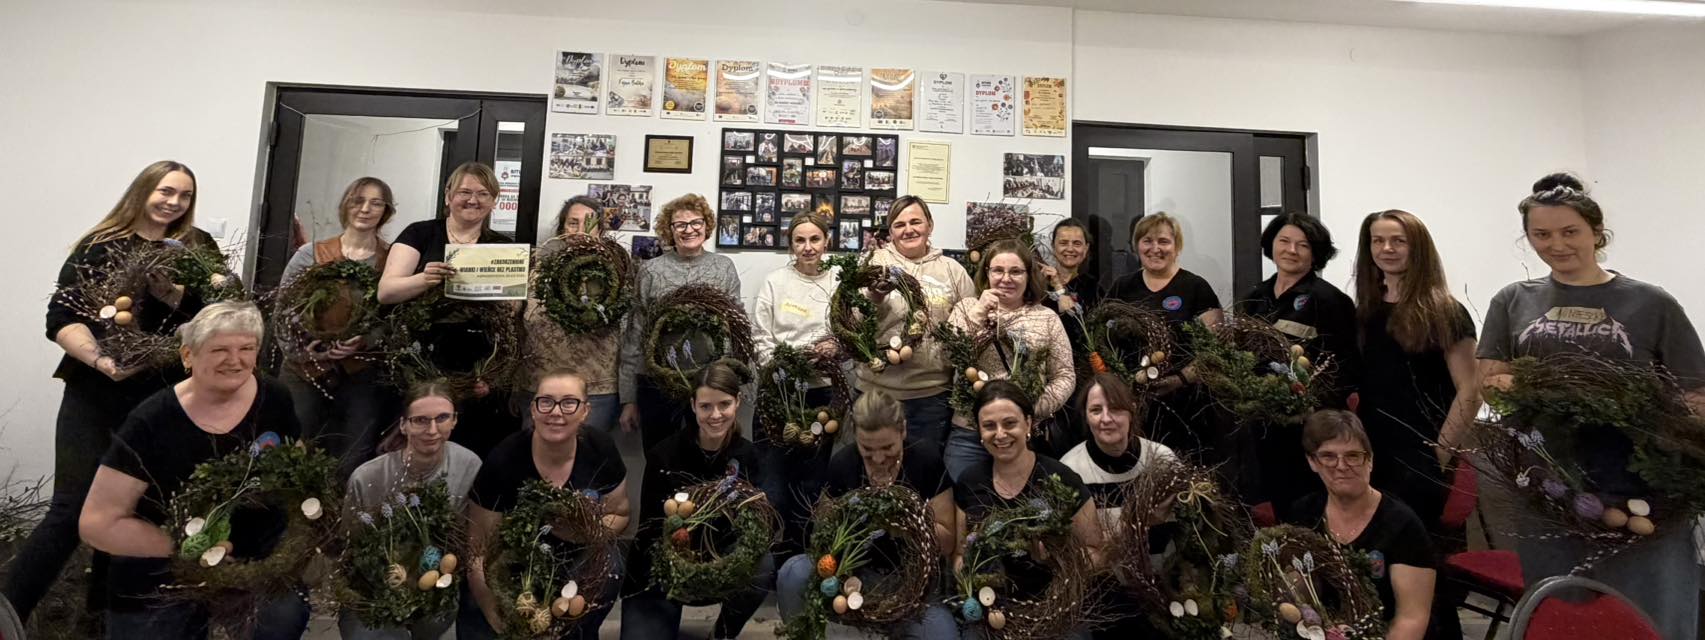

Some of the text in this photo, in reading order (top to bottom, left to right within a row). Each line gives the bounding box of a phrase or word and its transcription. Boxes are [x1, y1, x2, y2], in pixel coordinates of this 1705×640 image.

[620, 56, 645, 67] Dyplom
[668, 60, 706, 73] Dyplom
[721, 63, 753, 72] Dyplom
